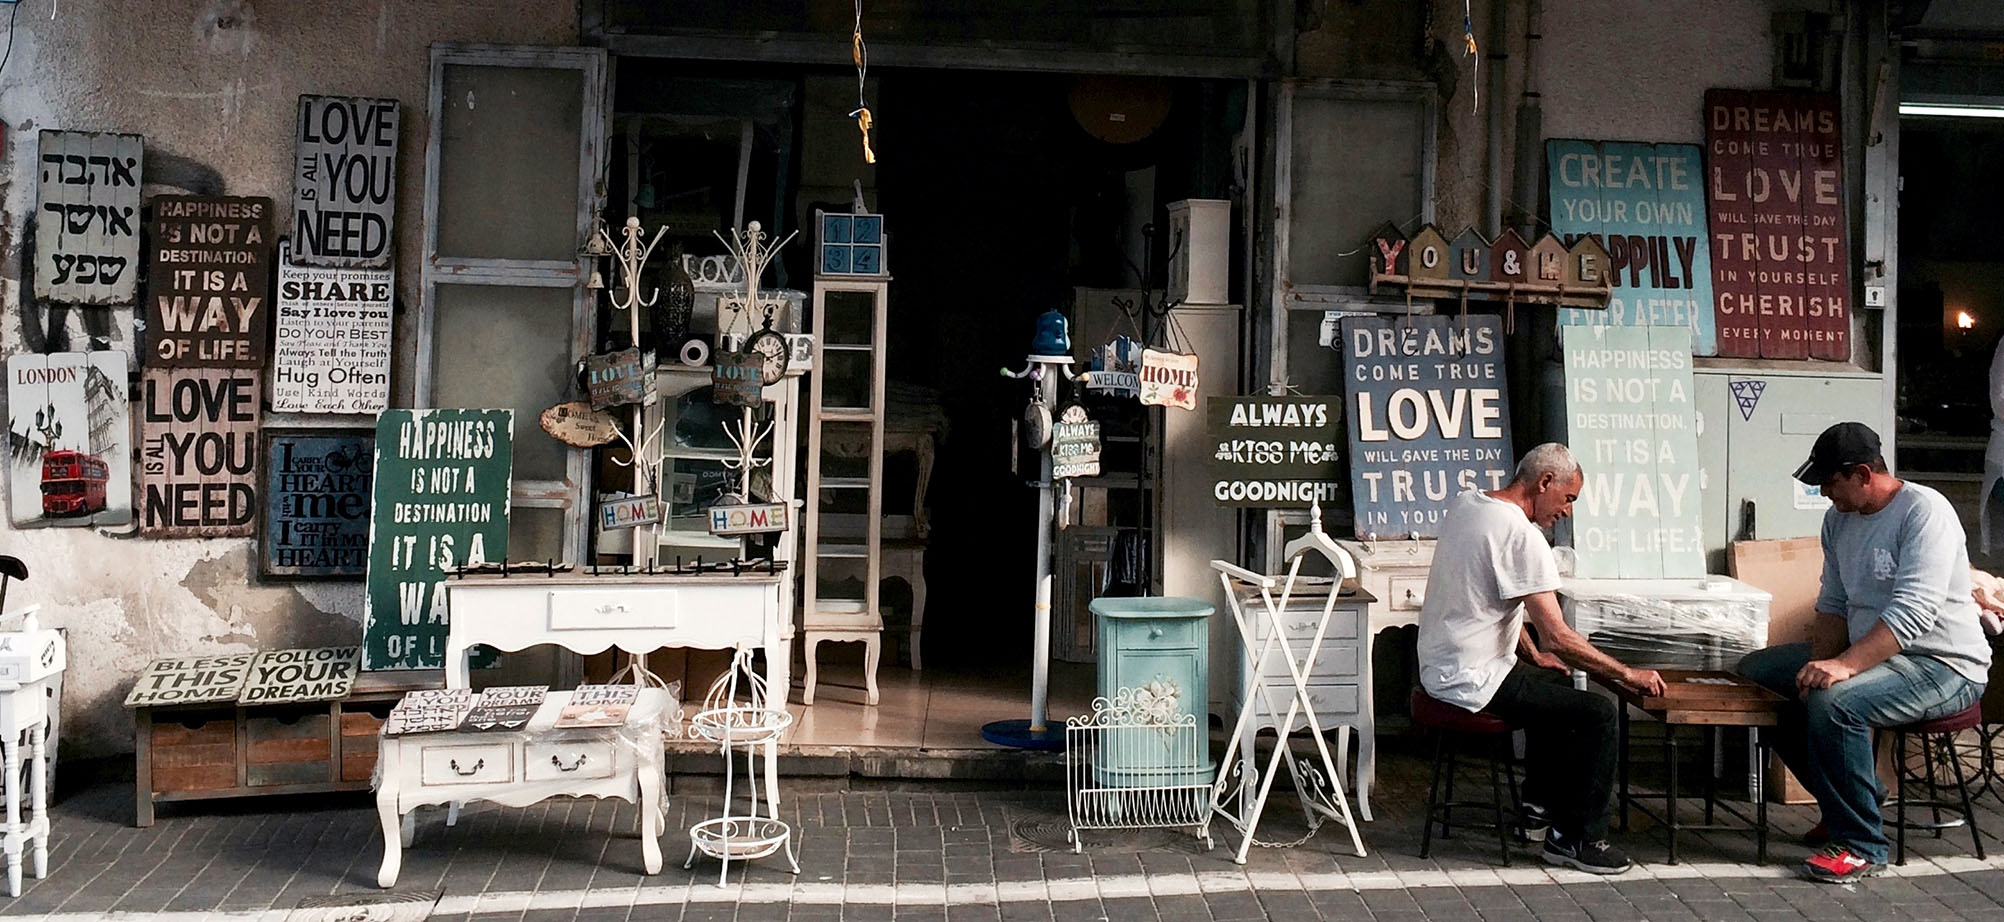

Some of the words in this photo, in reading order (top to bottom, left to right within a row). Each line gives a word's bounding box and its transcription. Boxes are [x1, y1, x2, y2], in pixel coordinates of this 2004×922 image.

[303, 101, 395, 147] LOVE
[1713, 105, 1834, 133] DREAMS
[1713, 138, 1769, 156] COME
[1782, 142, 1834, 158] TRUE
[42, 154, 137, 187] אהבה
[303, 152, 318, 182] ALL
[1559, 152, 1690, 190] CREATE
[324, 153, 391, 204] YOU
[1713, 166, 1838, 205] LOVE
[301, 188, 316, 201] IS
[44, 202, 133, 237] אושר
[160, 202, 263, 219] HAPPINESS
[1562, 198, 1627, 223] YOUR
[1635, 199, 1693, 225] OWN
[1718, 212, 1746, 224] WILL
[1753, 212, 1782, 225] SAVE
[1786, 214, 1808, 226] THE
[1813, 215, 1838, 227] DAY
[160, 223, 182, 244] IS
[190, 223, 239, 244] NOT
[246, 225, 262, 244] A
[295, 209, 387, 258] NEED
[1716, 233, 1839, 264] TRUST
[52, 253, 127, 286] שפע
[282, 270, 310, 280] Keep
[313, 273, 338, 281] your
[340, 272, 391, 282] promises
[1720, 270, 1737, 282] IN
[1749, 271, 1839, 286] YOURSELF
[174, 270, 196, 290] IT
[203, 270, 225, 291] IS
[231, 272, 248, 291] A
[281, 281, 390, 302] SHARE
[158, 296, 262, 333] WAY
[280, 307, 311, 318] Say
[313, 308, 322, 317] I
[324, 308, 356, 318] love
[359, 310, 389, 320] you
[1719, 292, 1843, 318] CHERISH
[279, 327, 302, 339] DO
[304, 328, 346, 339] YOUR
[349, 329, 388, 340] BEST
[281, 318, 310, 326] Listen
[313, 319, 324, 327] to
[326, 320, 349, 328] your
[1353, 327, 1494, 358] DREAMS
[1723, 328, 1772, 341] EVERY
[1781, 330, 1845, 342] MOMENT
[158, 339, 190, 360] OF
[200, 339, 257, 361] LIFE.
[278, 348, 315, 357] Always
[318, 348, 337, 357] Tell
[340, 349, 357, 358] the
[360, 349, 387, 358] Truth
[1572, 350, 1684, 370] HAPPINESS
[278, 357, 315, 368] Laugh
[335, 358, 386, 367] Yourself
[1355, 364, 1420, 381] COME
[1435, 363, 1496, 380] TRUE
[17, 367, 77, 385] LONDON
[277, 367, 319, 388] Hug
[328, 366, 386, 384] Often
[1142, 365, 1196, 389] HOME
[146, 378, 254, 423] LOVE
[276, 388, 300, 397] Use
[308, 388, 339, 397] Kind
[347, 388, 386, 398] Words
[1574, 378, 1598, 403] IS
[1606, 377, 1661, 403] NOT
[1669, 378, 1687, 403] A
[276, 398, 309, 410] Love
[315, 398, 345, 410] Each
[351, 399, 385, 410] Other
[1358, 388, 1502, 441] LOVE
[1230, 403, 1327, 427] ALWAYS
[1576, 413, 1688, 430] DESTINATION.
[399, 420, 495, 460] HAPPINESS
[1058, 423, 1095, 438] ALWAYS
[146, 434, 165, 460] ALL
[164, 431, 254, 476] YOU
[1059, 443, 1080, 457] KISS
[1232, 440, 1283, 464] KISS
[1364, 450, 1398, 463] WILL
[1403, 450, 1438, 463] SAVE
[1444, 449, 1470, 461] THE
[1475, 448, 1501, 461] DAY
[1595, 439, 1617, 464] IT
[1626, 439, 1650, 464] IS
[1658, 440, 1676, 464] A
[146, 461, 165, 476] IS
[279, 443, 295, 473] I
[292, 456, 323, 464] CARRY
[295, 464, 325, 473] YOUR
[1053, 462, 1100, 476] GOODNIGHT
[279, 473, 372, 493] HEART
[411, 466, 425, 494] IS
[430, 467, 460, 494] NOT
[465, 466, 475, 494] A
[1362, 469, 1506, 503] TRUST
[1214, 480, 1338, 502] GOODNIGHT
[1583, 472, 1690, 518] WAY
[146, 482, 256, 527] NEED
[394, 502, 491, 523] DESTINATION
[604, 502, 657, 525] HOME
[713, 507, 784, 529] HOME
[1368, 511, 1388, 525] IN
[277, 520, 293, 546] I
[293, 522, 343, 537] carry
[300, 534, 320, 547] IT
[341, 534, 369, 547] MY
[1585, 527, 1619, 552] OF
[1630, 528, 1692, 553] LIFE.
[276, 548, 369, 567] HEART
[392, 535, 417, 571] IT
[428, 534, 455, 573] IS
[468, 533, 485, 567] A
[262, 647, 358, 665] FOLLOW
[387, 634, 417, 658] OF
[153, 656, 249, 672] BLESS
[258, 661, 350, 685] YOUR
[150, 669, 241, 690] THIS
[246, 680, 347, 700] DREAMS
[133, 686, 236, 702] HOME
[480, 698, 541, 707] DREAMS
[485, 691, 543, 699] YOUR
[578, 690, 634, 699] THIS
